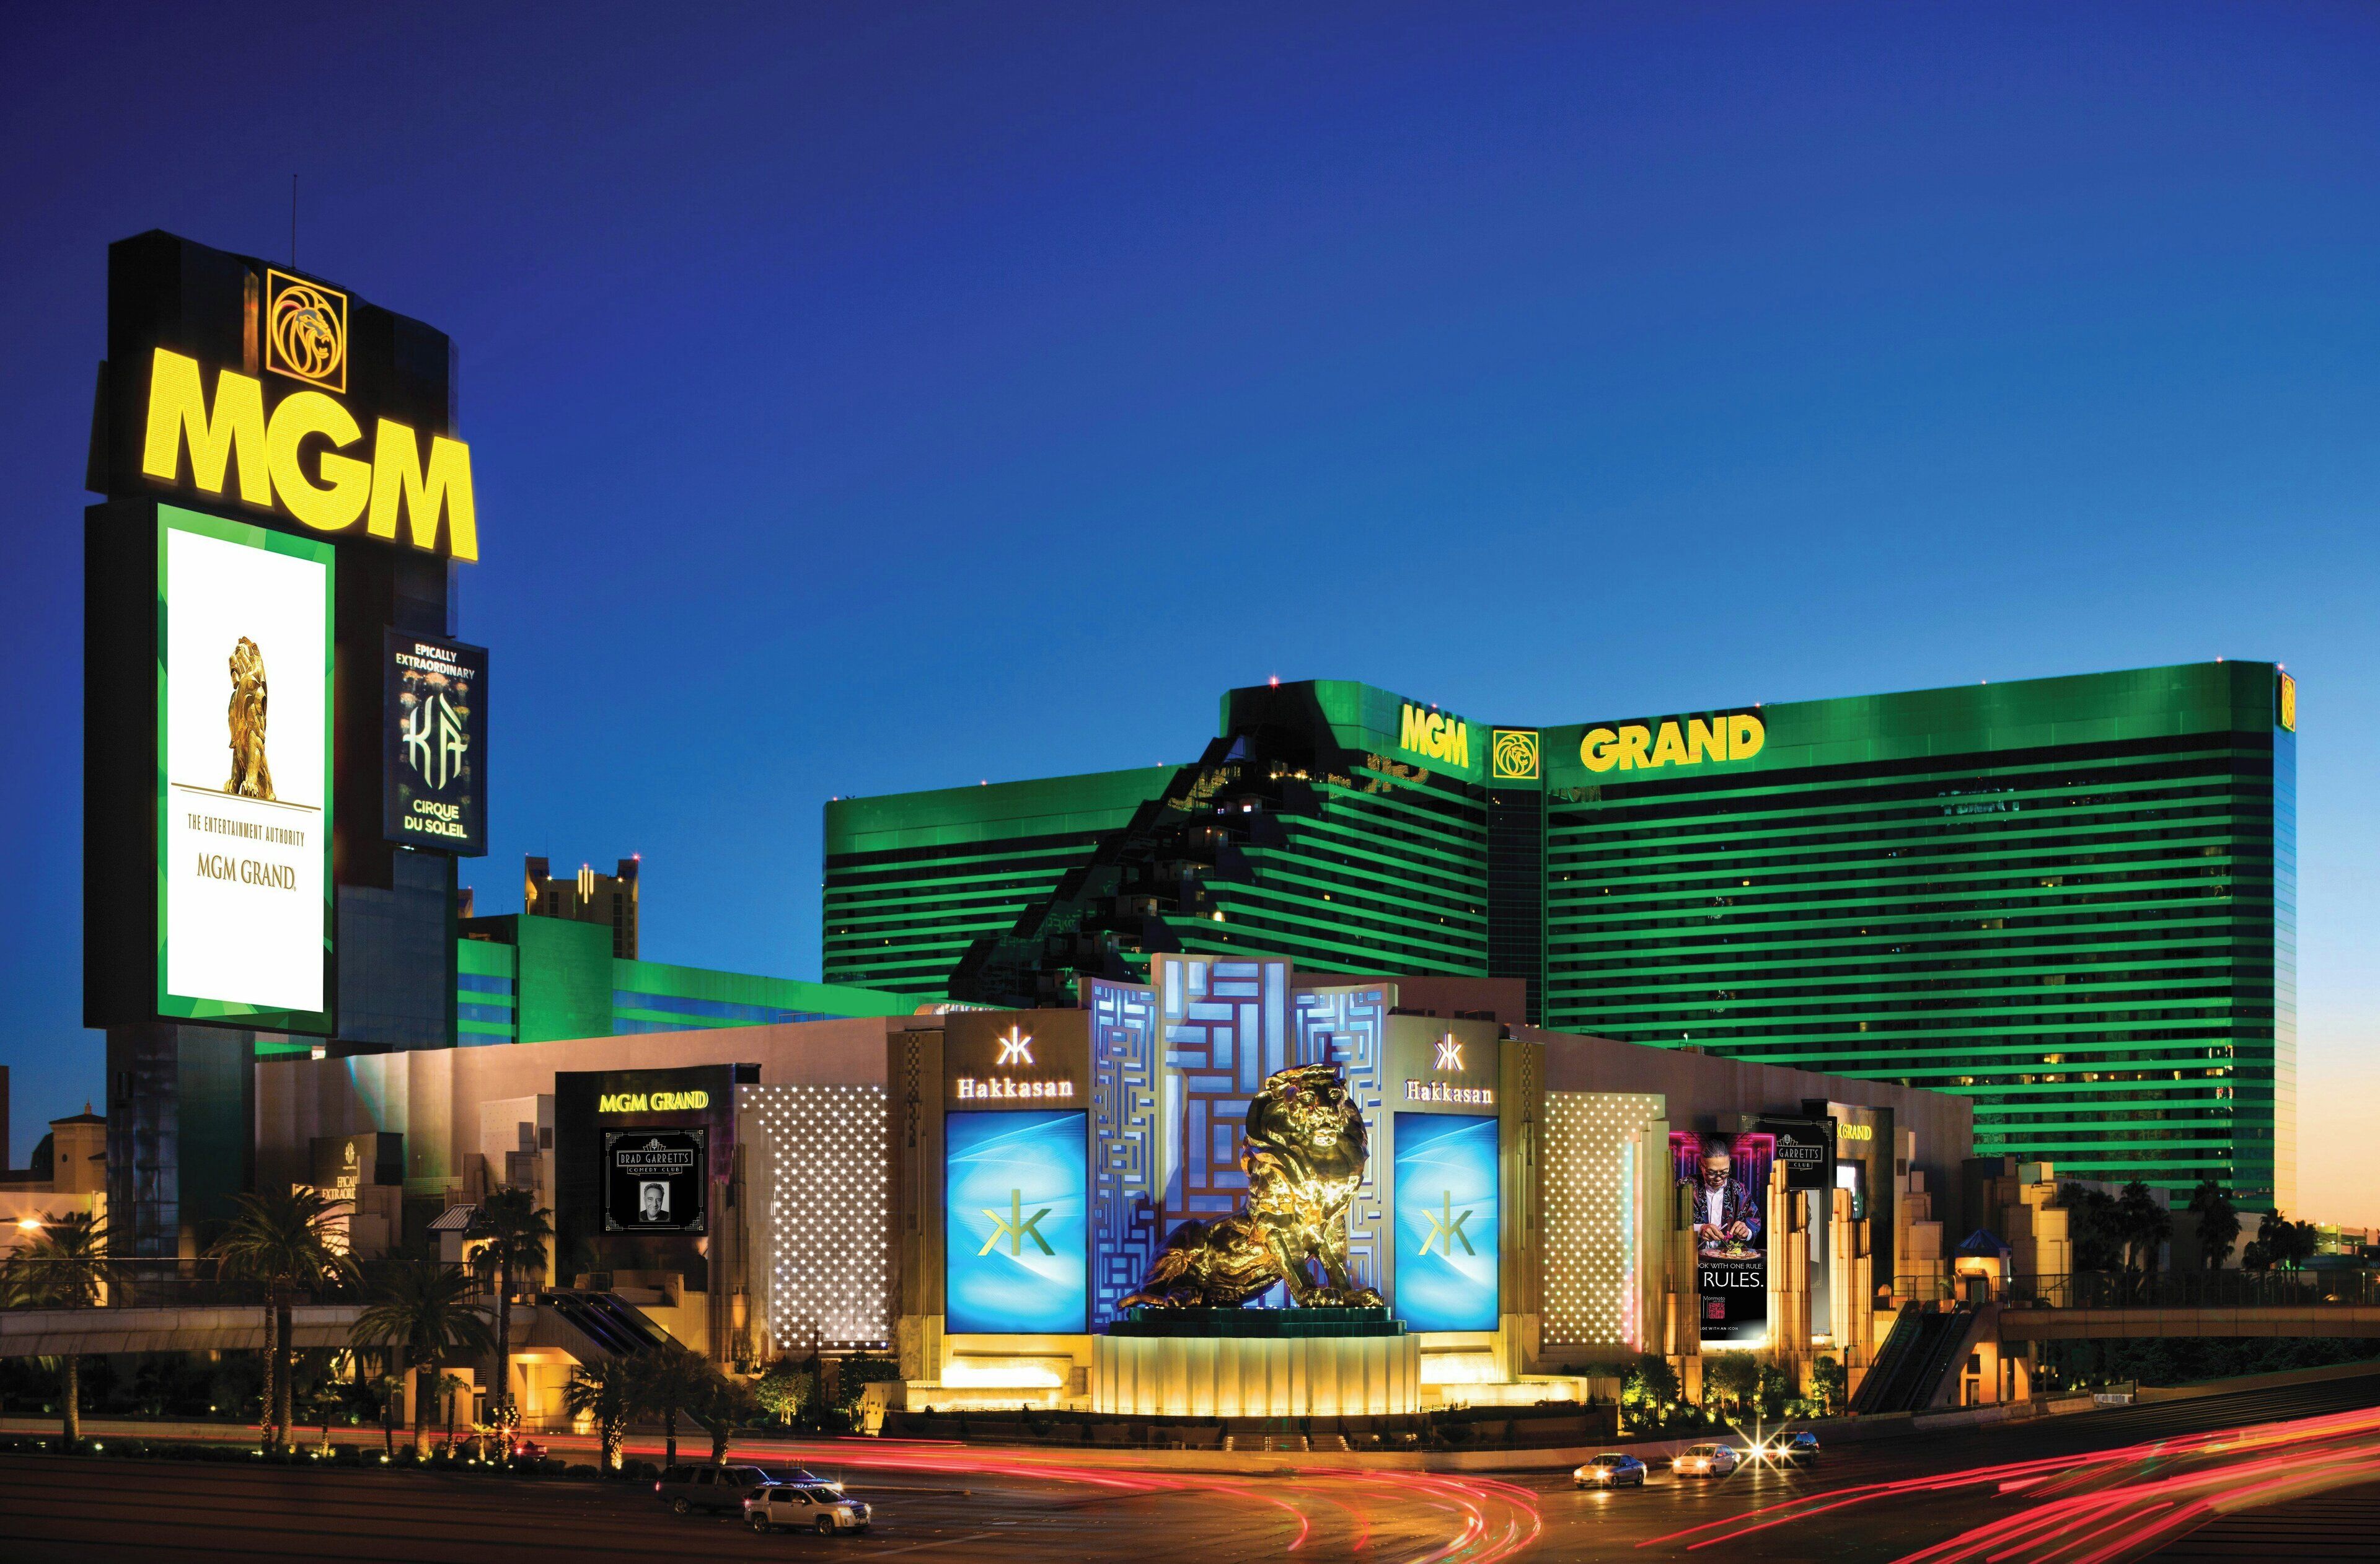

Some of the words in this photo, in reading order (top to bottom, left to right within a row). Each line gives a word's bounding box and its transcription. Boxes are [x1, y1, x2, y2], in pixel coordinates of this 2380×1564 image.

[142, 347, 478, 561] MGM
[415, 643, 457, 662] EPICALLY
[395, 652, 475, 680] EXTRAORDINARY
[1400, 703, 1469, 768] MGM
[1580, 714, 1765, 772] GRAND
[413, 799, 459, 820] CIRQUE
[188, 813, 201, 830] THE
[205, 816, 262, 840] ENTERTAINMENT
[265, 826, 304, 847] AUTHORITY
[405, 816, 423, 831] DU
[425, 819, 467, 838] SOLEIL
[196, 852, 237, 882] MGM
[240, 859, 296, 890] GRAND
[957, 1077, 1074, 1099] Hakkasan
[1404, 1079, 1493, 1104] Hakkasan
[599, 1093, 650, 1112] MGM
[650, 1091, 709, 1111] GRAND
[1842, 1123, 1872, 1141] GRAND
[621, 1154, 641, 1163] BRAD
[645, 1153, 689, 1163] GARRETT'S
[1779, 1148, 1818, 1159] GARRETT'S
[1704, 1272, 1764, 1288] RULES.
